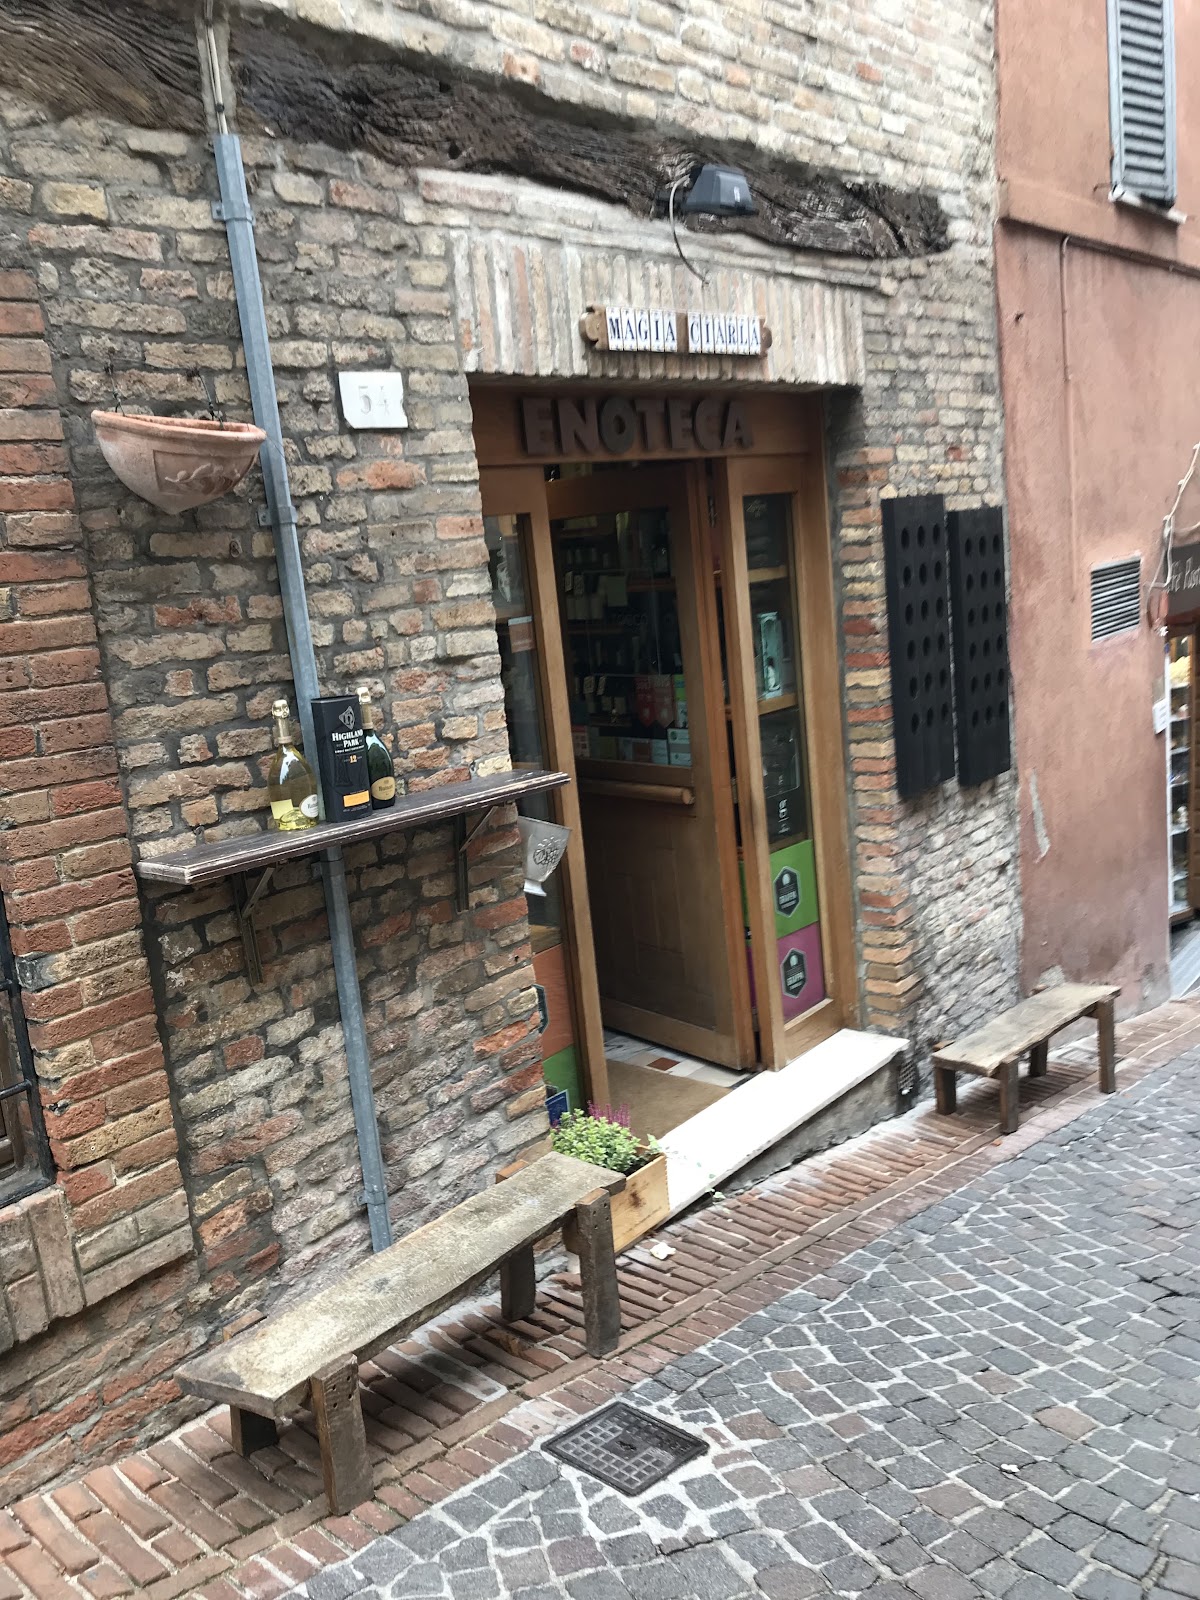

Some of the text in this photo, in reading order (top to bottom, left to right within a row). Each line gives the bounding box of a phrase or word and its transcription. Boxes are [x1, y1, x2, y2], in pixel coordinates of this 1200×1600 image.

[608, 316, 760, 346] MAGIA CIARLA
[521, 397, 754, 455] ENOTECA
[332, 729, 364, 742] HIGHLAND
[343, 738, 360, 748] PARK
[349, 754, 358, 764] 12
